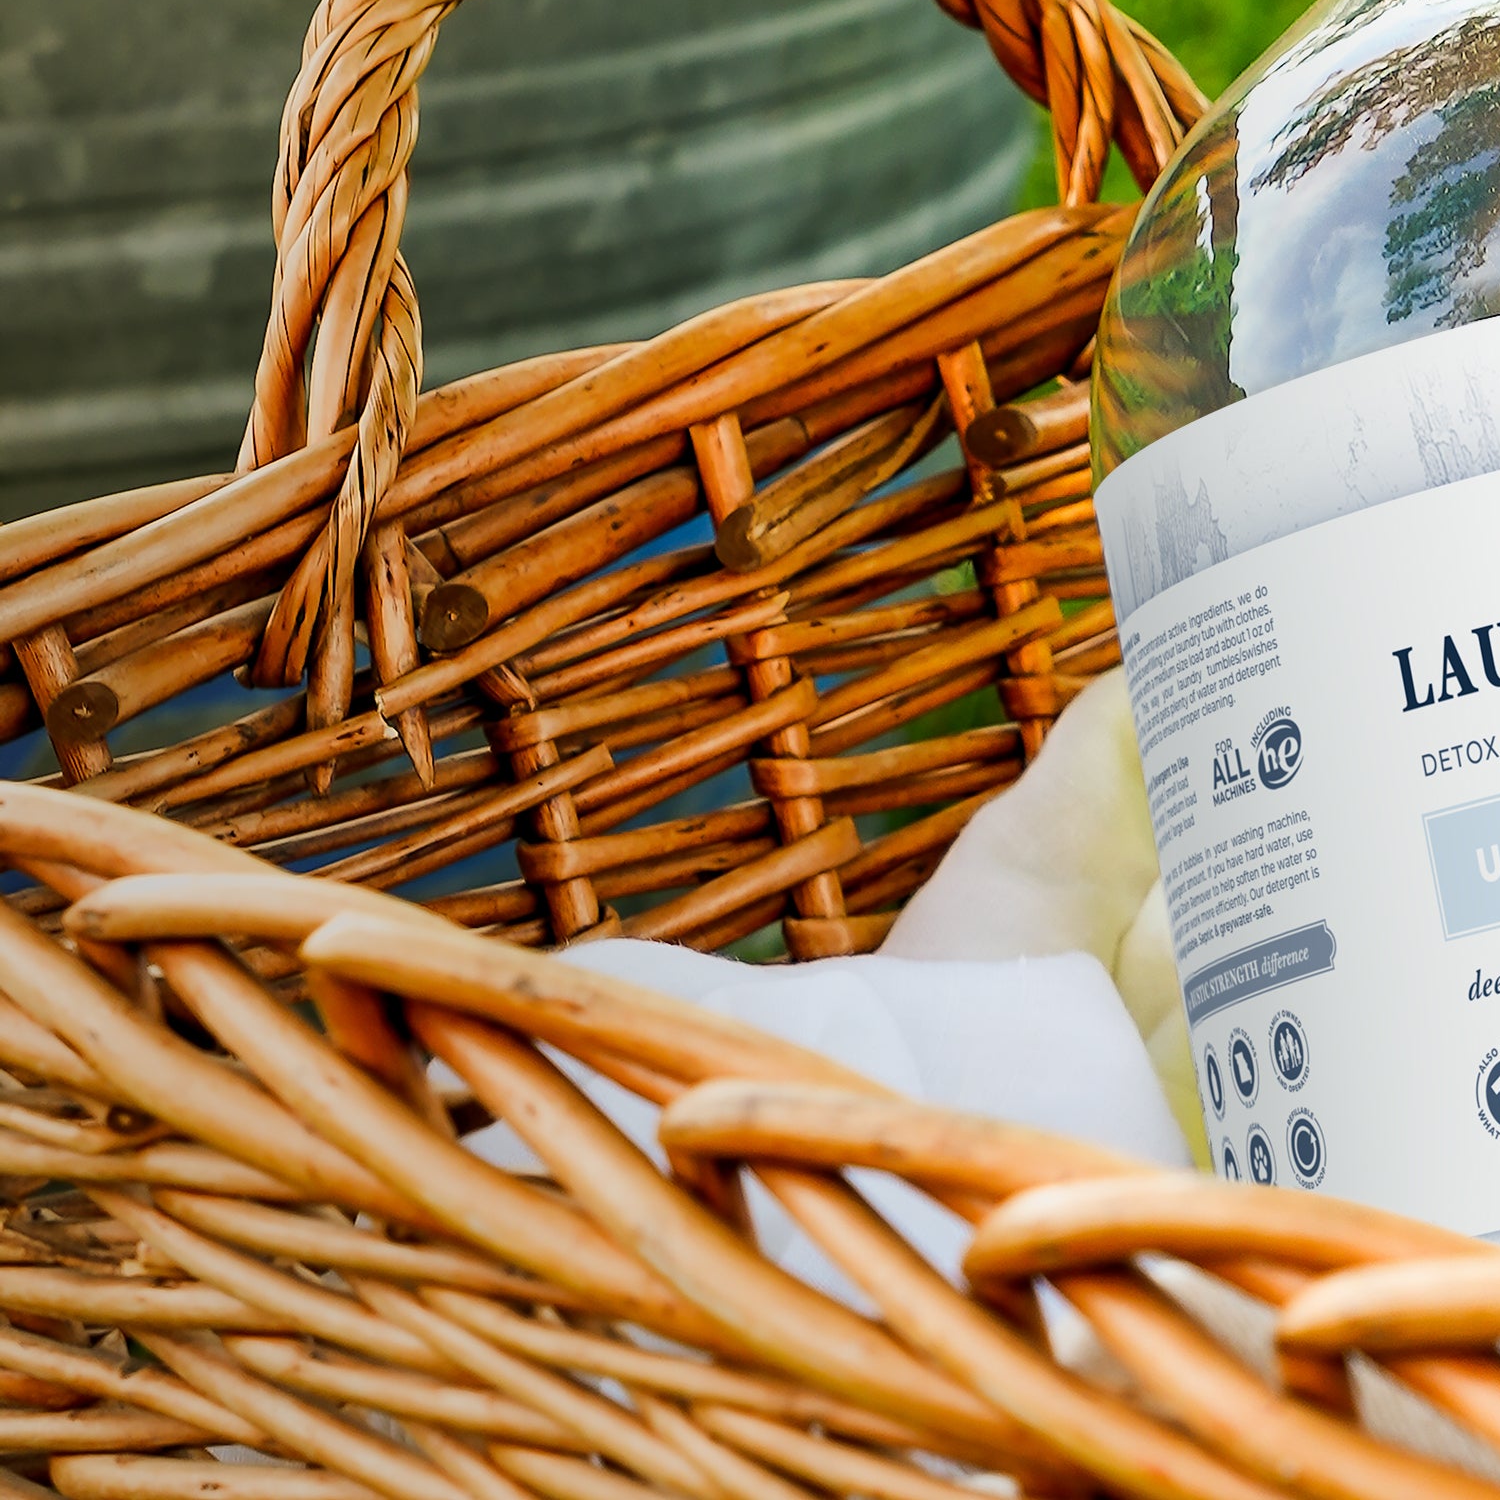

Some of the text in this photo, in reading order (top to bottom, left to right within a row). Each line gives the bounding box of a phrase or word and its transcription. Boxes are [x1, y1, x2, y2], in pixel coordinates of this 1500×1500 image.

[1189, 585, 1267, 628] ingredients, we do
[1201, 604, 1271, 641] tub with clothes.
[1205, 618, 1275, 658] and about 1 oz of
[1177, 670, 1202, 691] laundry
[1207, 638, 1278, 675] tumbles/swishes
[1197, 683, 1217, 700] water
[1219, 673, 1235, 689] and
[1236, 655, 1281, 682] detergent
[1180, 708, 1200, 732] proper
[1202, 693, 1236, 716] cleaning.
[1250, 706, 1291, 748] INCLUDING
[1215, 739, 1233, 755] FOR
[1421, 736, 1499, 777] DETOX
[1214, 748, 1250, 789] ALL
[1212, 779, 1256, 807] MACHINES
[1231, 810, 1311, 848] washing machine,
[1226, 828, 1313, 871] have hard water, use
[1236, 848, 1316, 887] soften the water so
[1250, 866, 1320, 900] Our detergent is
[1220, 904, 1274, 938] greywater-safe.
[1210, 946, 1310, 994] STRENGTH difference
[1268, 1010, 1301, 1036] FAMILY OWNED
[1277, 1065, 1309, 1092] AND OPERATED
[1478, 1047, 1498, 1074] ALSO
[1287, 1107, 1313, 1126] REFILLABLE
[1477, 1109, 1500, 1140] WHAT
[1295, 1166, 1325, 1189] CLOSED LOOP
